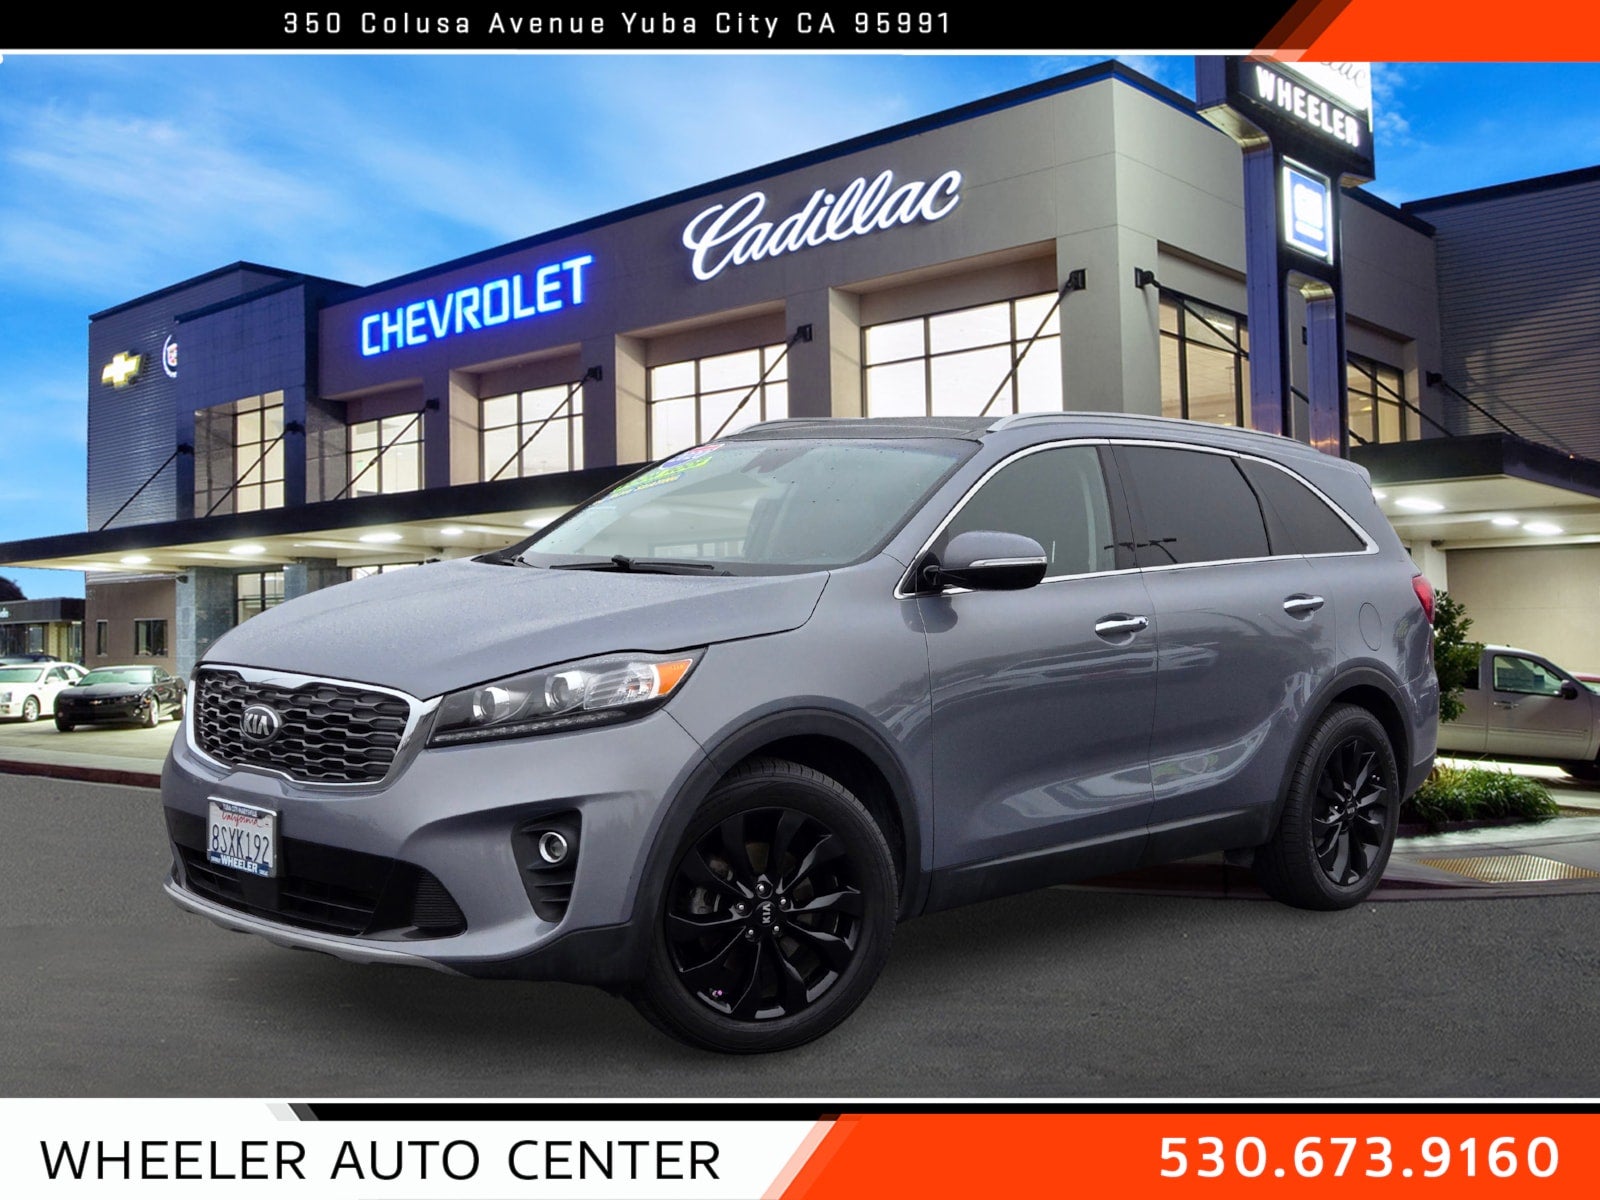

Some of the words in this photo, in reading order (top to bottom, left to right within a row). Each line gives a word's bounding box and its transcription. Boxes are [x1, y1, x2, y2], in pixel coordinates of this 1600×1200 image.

[1255, 65, 1360, 148] WHEELER
[682, 169, 963, 281] Cadillac
[361, 254, 593, 357] CHEVROLET
[243, 712, 270, 736] KIA
[211, 823, 270, 866] 8SXK192
[220, 854, 258, 874] WHEELER
[761, 903, 772, 924] KIA
